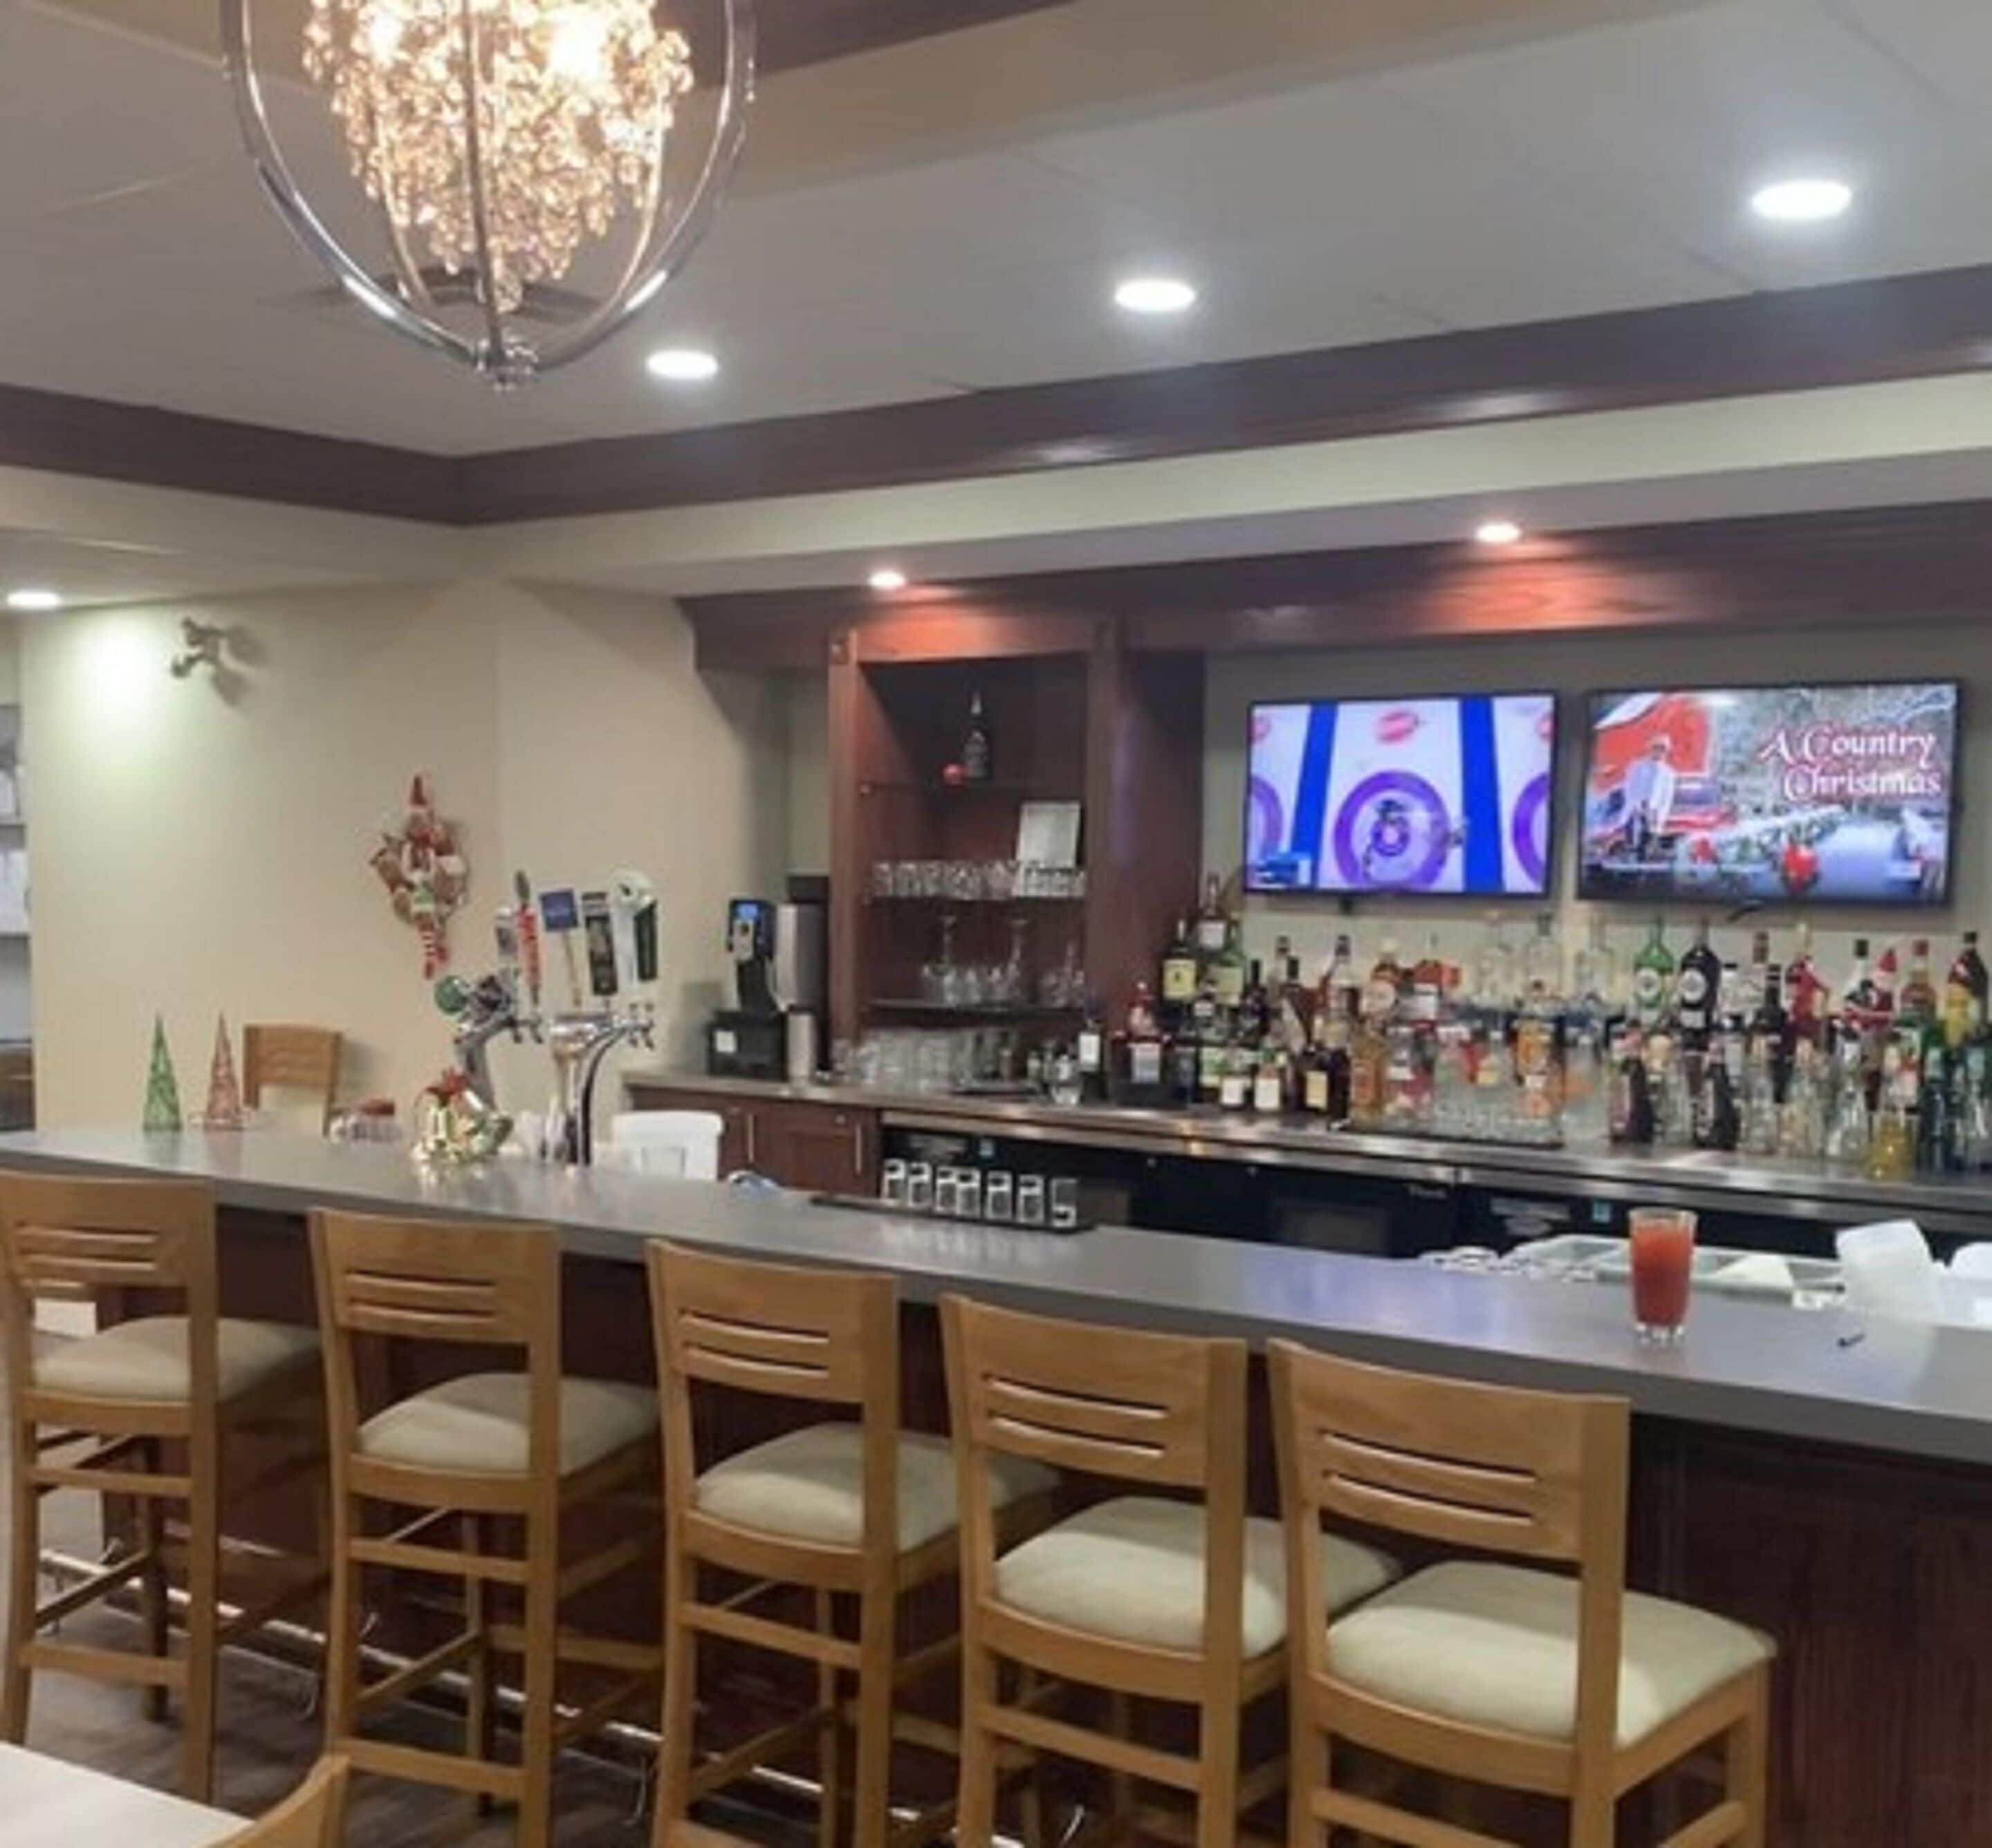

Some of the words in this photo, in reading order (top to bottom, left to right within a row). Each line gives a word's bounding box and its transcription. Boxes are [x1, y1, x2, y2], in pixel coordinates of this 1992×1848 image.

[1756, 726, 1794, 764] A
[1802, 724, 1936, 769] Country
[1783, 765, 1942, 800] Christmas
